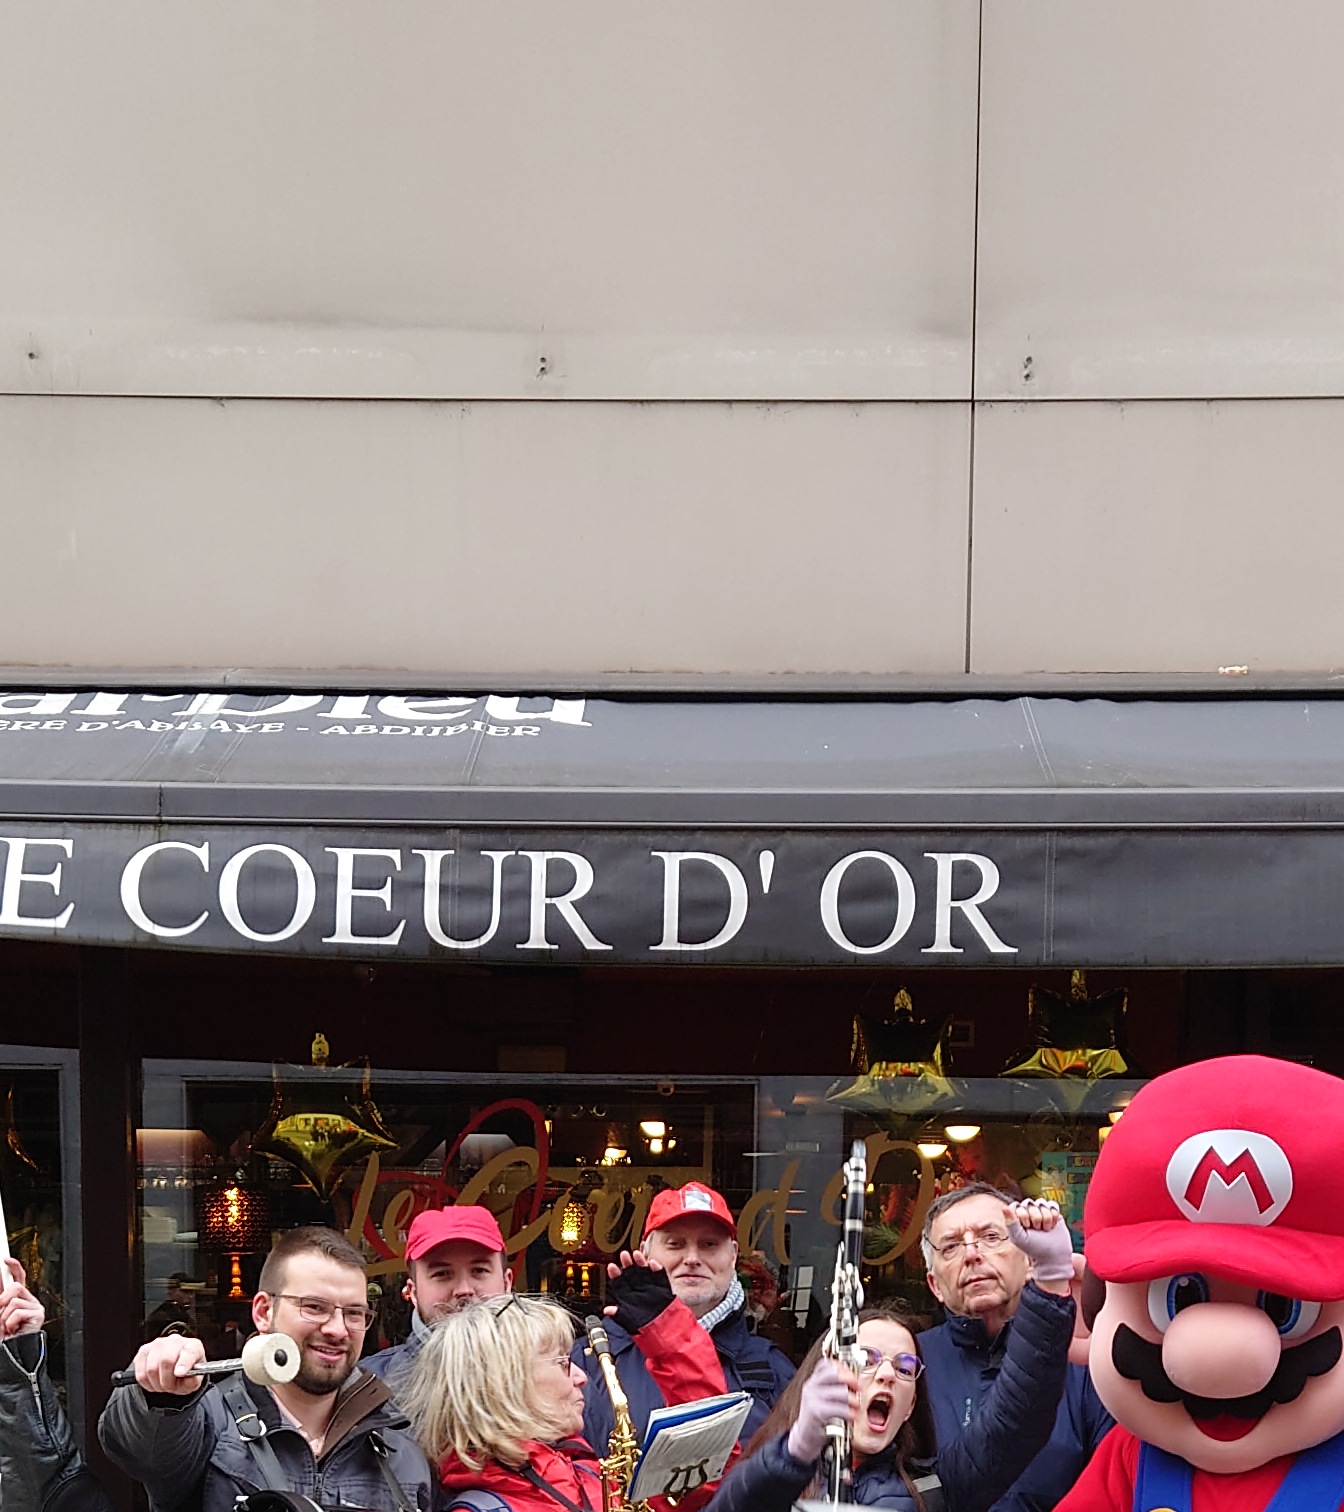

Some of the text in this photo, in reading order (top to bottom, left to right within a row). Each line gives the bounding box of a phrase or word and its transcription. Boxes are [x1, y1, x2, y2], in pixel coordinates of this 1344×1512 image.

[120, 841, 613, 952] COEUR
[820, 850, 1018, 955] OR
[1184, 1145, 1275, 1215] M
